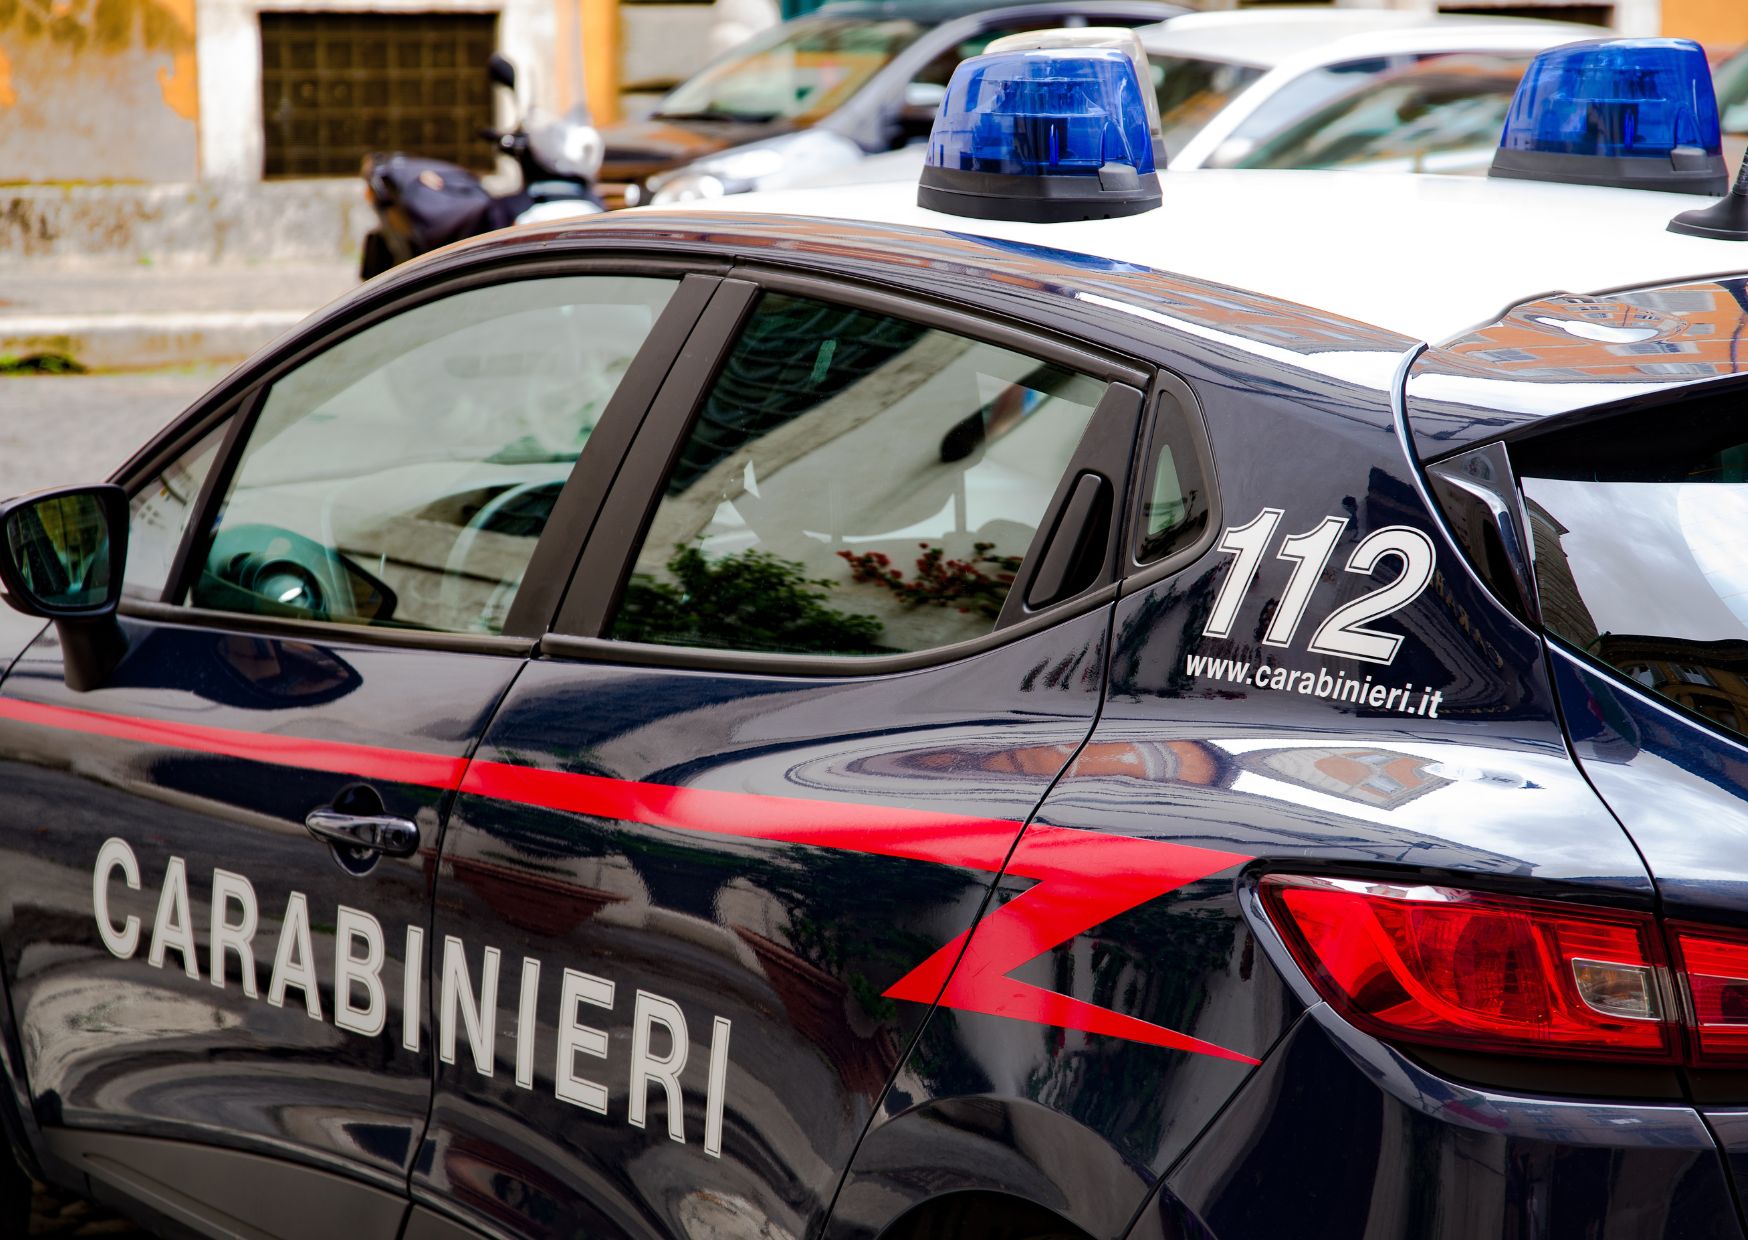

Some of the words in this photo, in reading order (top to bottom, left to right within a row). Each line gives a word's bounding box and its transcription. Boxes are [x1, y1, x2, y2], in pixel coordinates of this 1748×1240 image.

[1202, 507, 1437, 666] 112
[1186, 654, 1443, 719] www.carabinieri.it
[92, 837, 731, 1159] CARABINIERI
